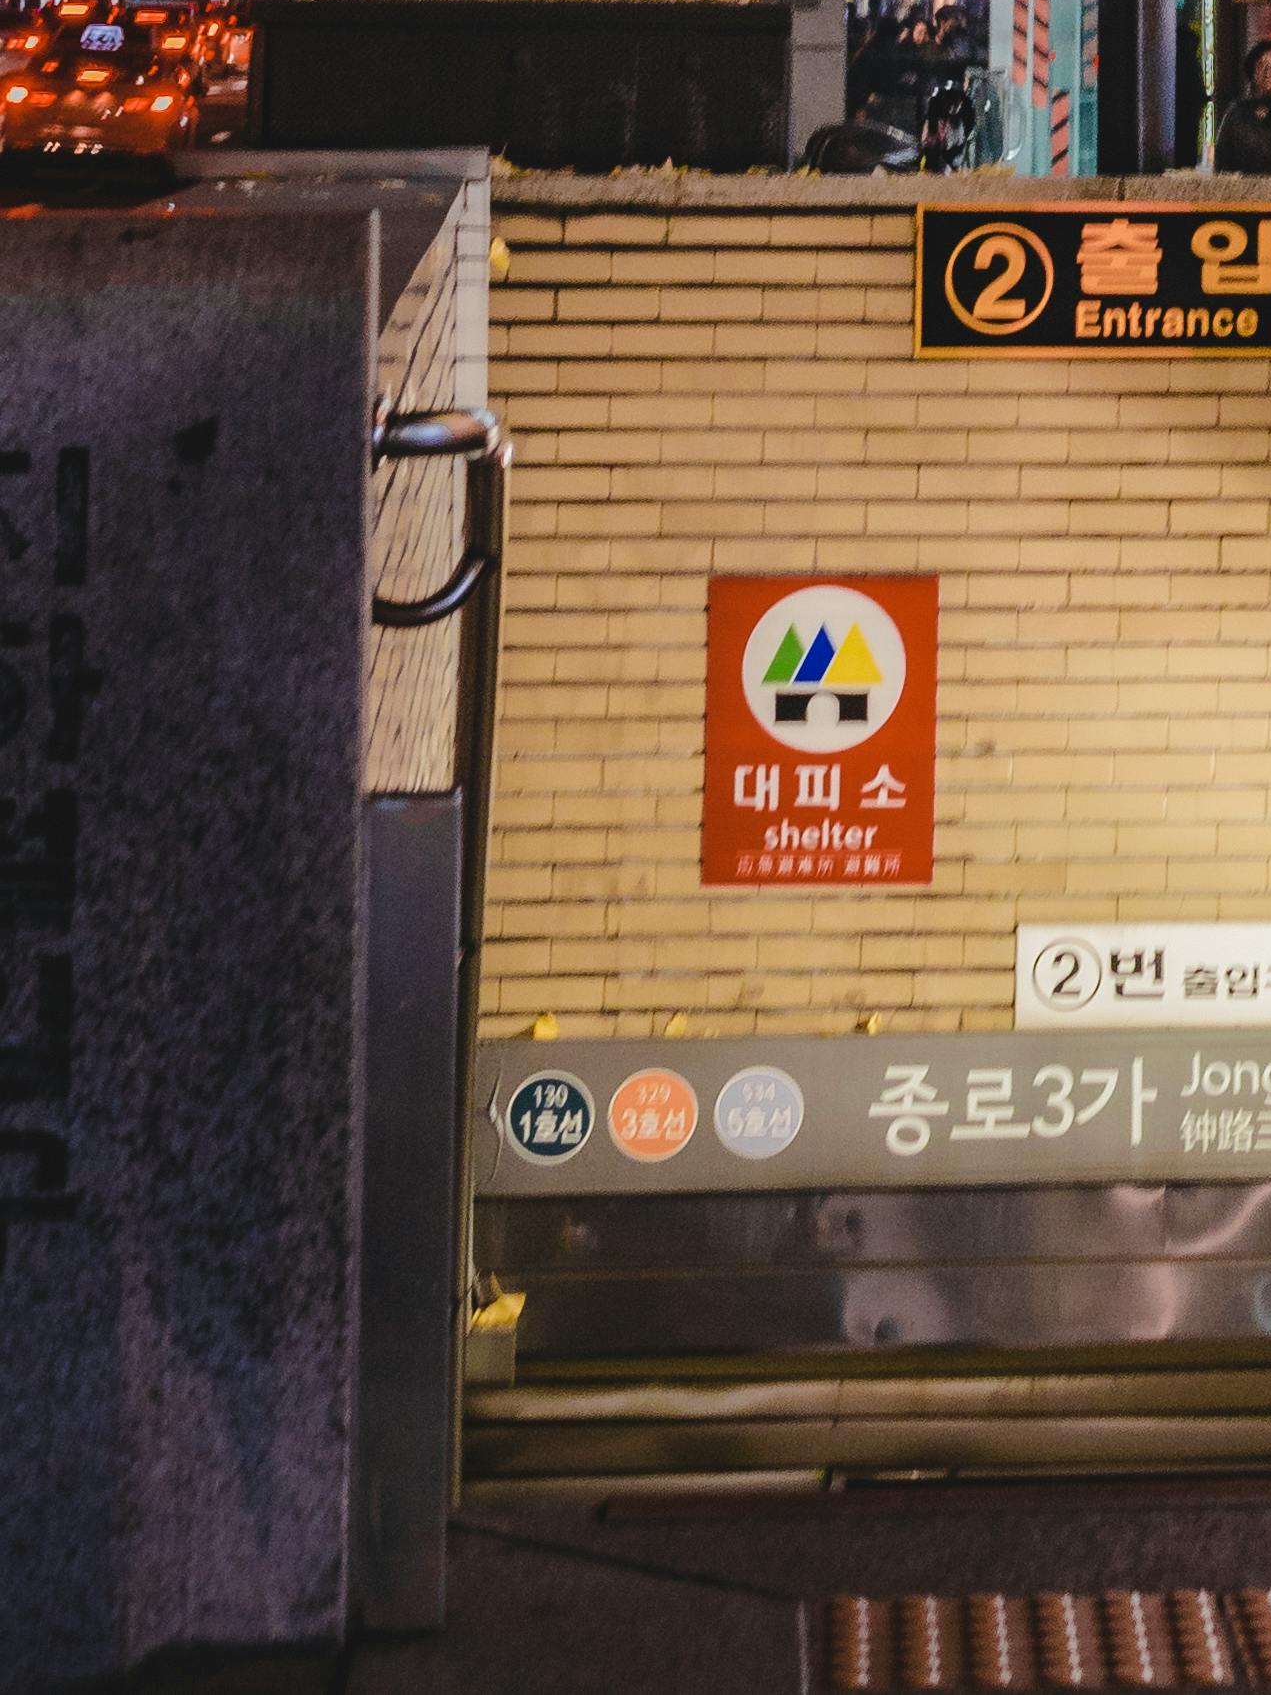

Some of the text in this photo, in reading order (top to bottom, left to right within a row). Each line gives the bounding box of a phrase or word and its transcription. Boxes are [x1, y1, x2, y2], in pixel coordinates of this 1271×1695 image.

[972, 237, 1029, 321] 2
[1075, 299, 1260, 341] Entrance
[733, 762, 908, 813] 대피소
[763, 816, 879, 852] shelter
[1049, 949, 1083, 1000] 2
[1108, 946, 1167, 1001] 번
[533, 1084, 570, 1110] 130
[868, 1056, 1158, 1158] 종로3가
[518, 1109, 584, 1145] 1호선
[620, 1106, 686, 1142] 3호선
